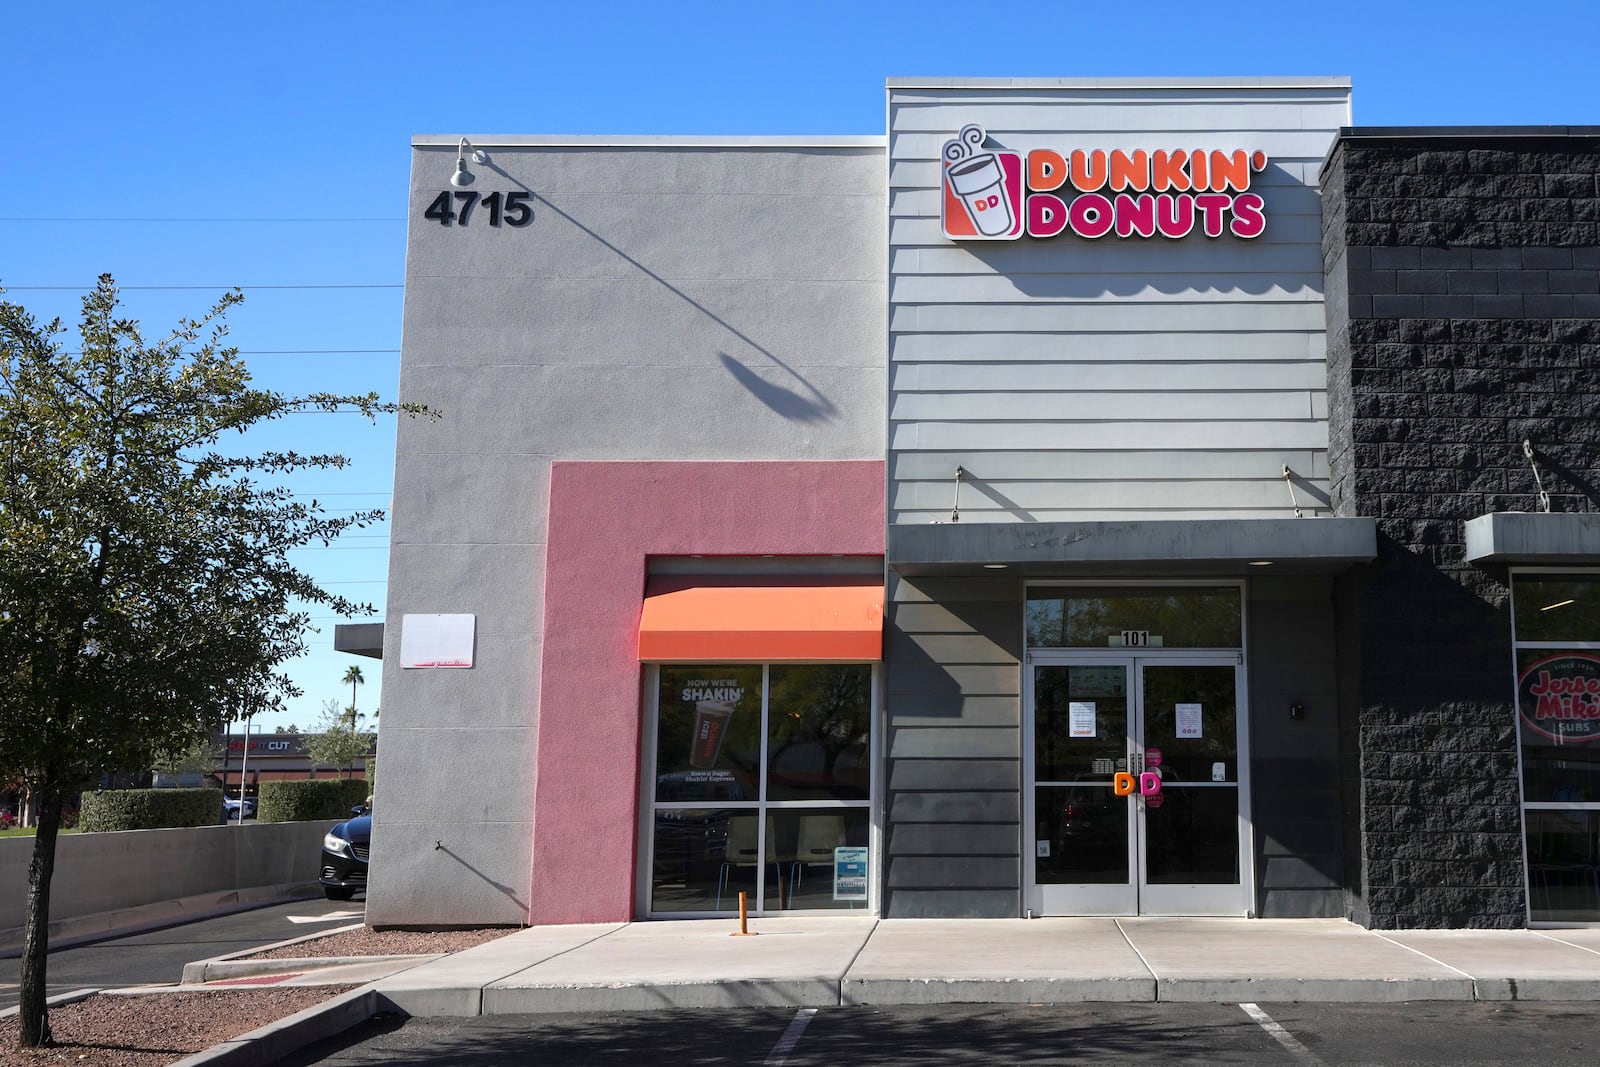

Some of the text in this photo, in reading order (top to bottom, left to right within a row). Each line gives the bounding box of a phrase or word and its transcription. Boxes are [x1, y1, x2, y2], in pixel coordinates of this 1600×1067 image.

[1026, 148, 1268, 193] DUNKIN'
[424, 191, 532, 227] 4715
[1026, 193, 1267, 239] DONUTS
[1122, 631, 1148, 646] 101
[1530, 671, 1600, 695] Jerse
[681, 687, 745, 702] SHAKIN'
[1536, 694, 1600, 720] Mike'
[701, 720, 711, 740] ICED
[1559, 722, 1591, 732] SUBS
[229, 741, 257, 751] KEP
[268, 741, 290, 750] CUT
